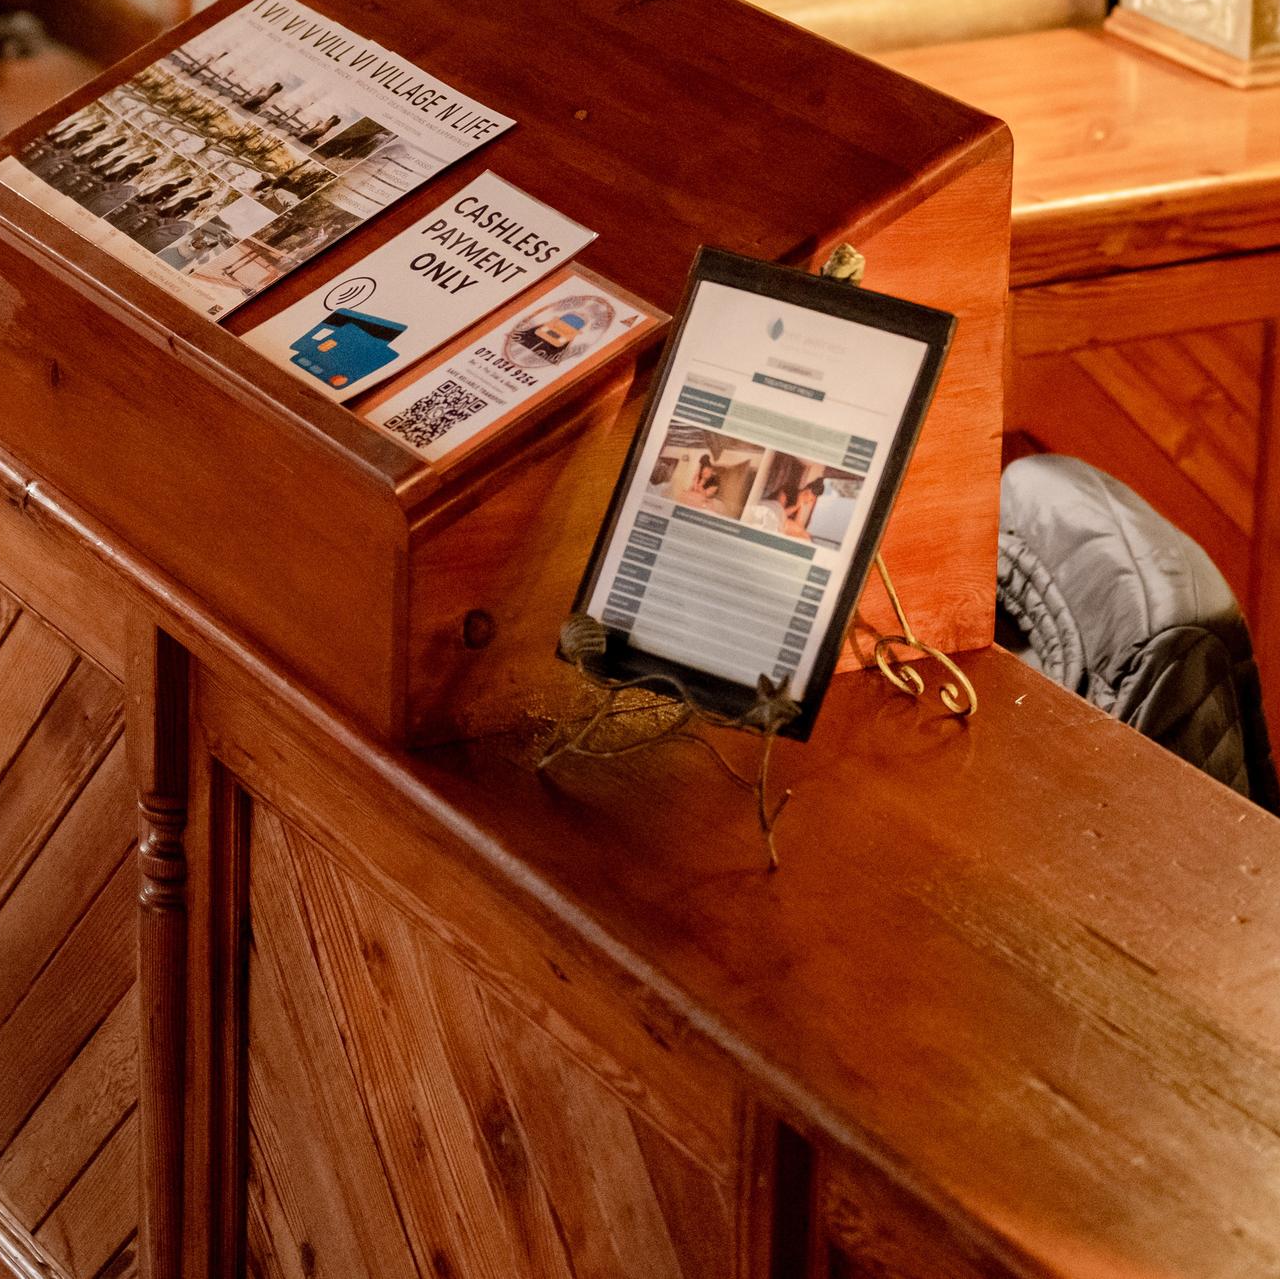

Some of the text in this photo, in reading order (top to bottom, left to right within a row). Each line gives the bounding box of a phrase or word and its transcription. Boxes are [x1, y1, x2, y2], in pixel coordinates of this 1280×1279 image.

[370, 61, 448, 113] VILLAGE
[434, 103, 463, 122] N
[450, 111, 499, 141] LIFE
[421, 218, 528, 283] PAYMENT
[454, 196, 561, 263] CASHLESS
[409, 252, 479, 295] ONLY
[474, 347, 496, 362] 071
[492, 358, 516, 372] 034
[510, 369, 539, 387] 9254
